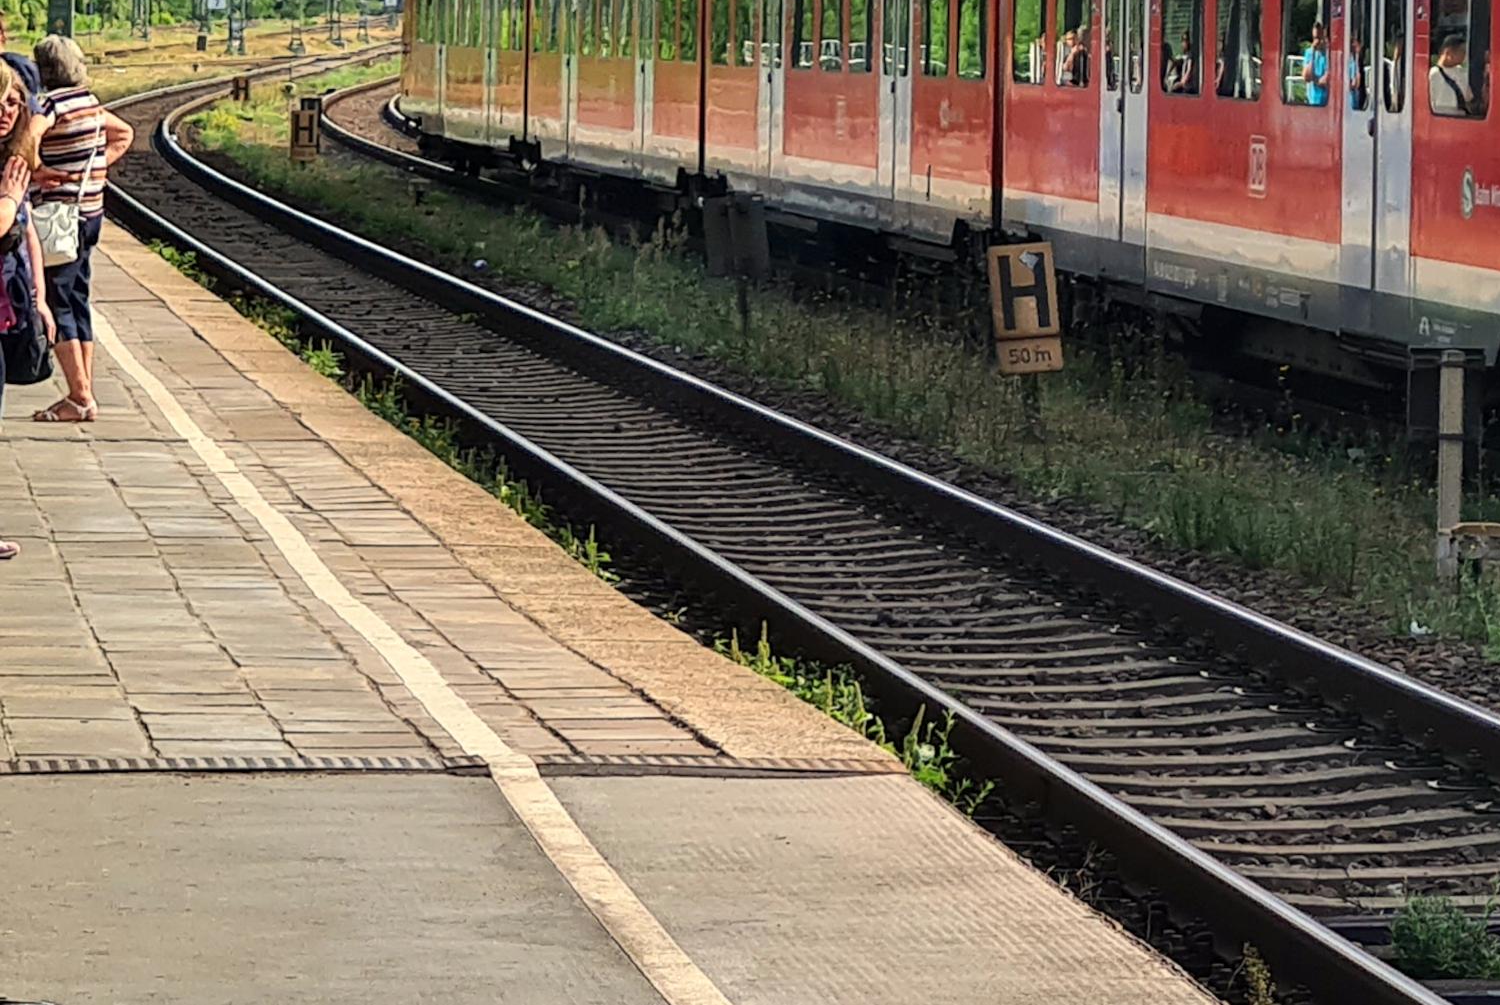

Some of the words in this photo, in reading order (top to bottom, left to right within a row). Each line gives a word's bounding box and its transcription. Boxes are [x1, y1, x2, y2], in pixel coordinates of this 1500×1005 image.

[295, 114, 314, 143] H
[998, 252, 1050, 330] H
[1009, 347, 1030, 364] 50
[1035, 349, 1052, 363] m
